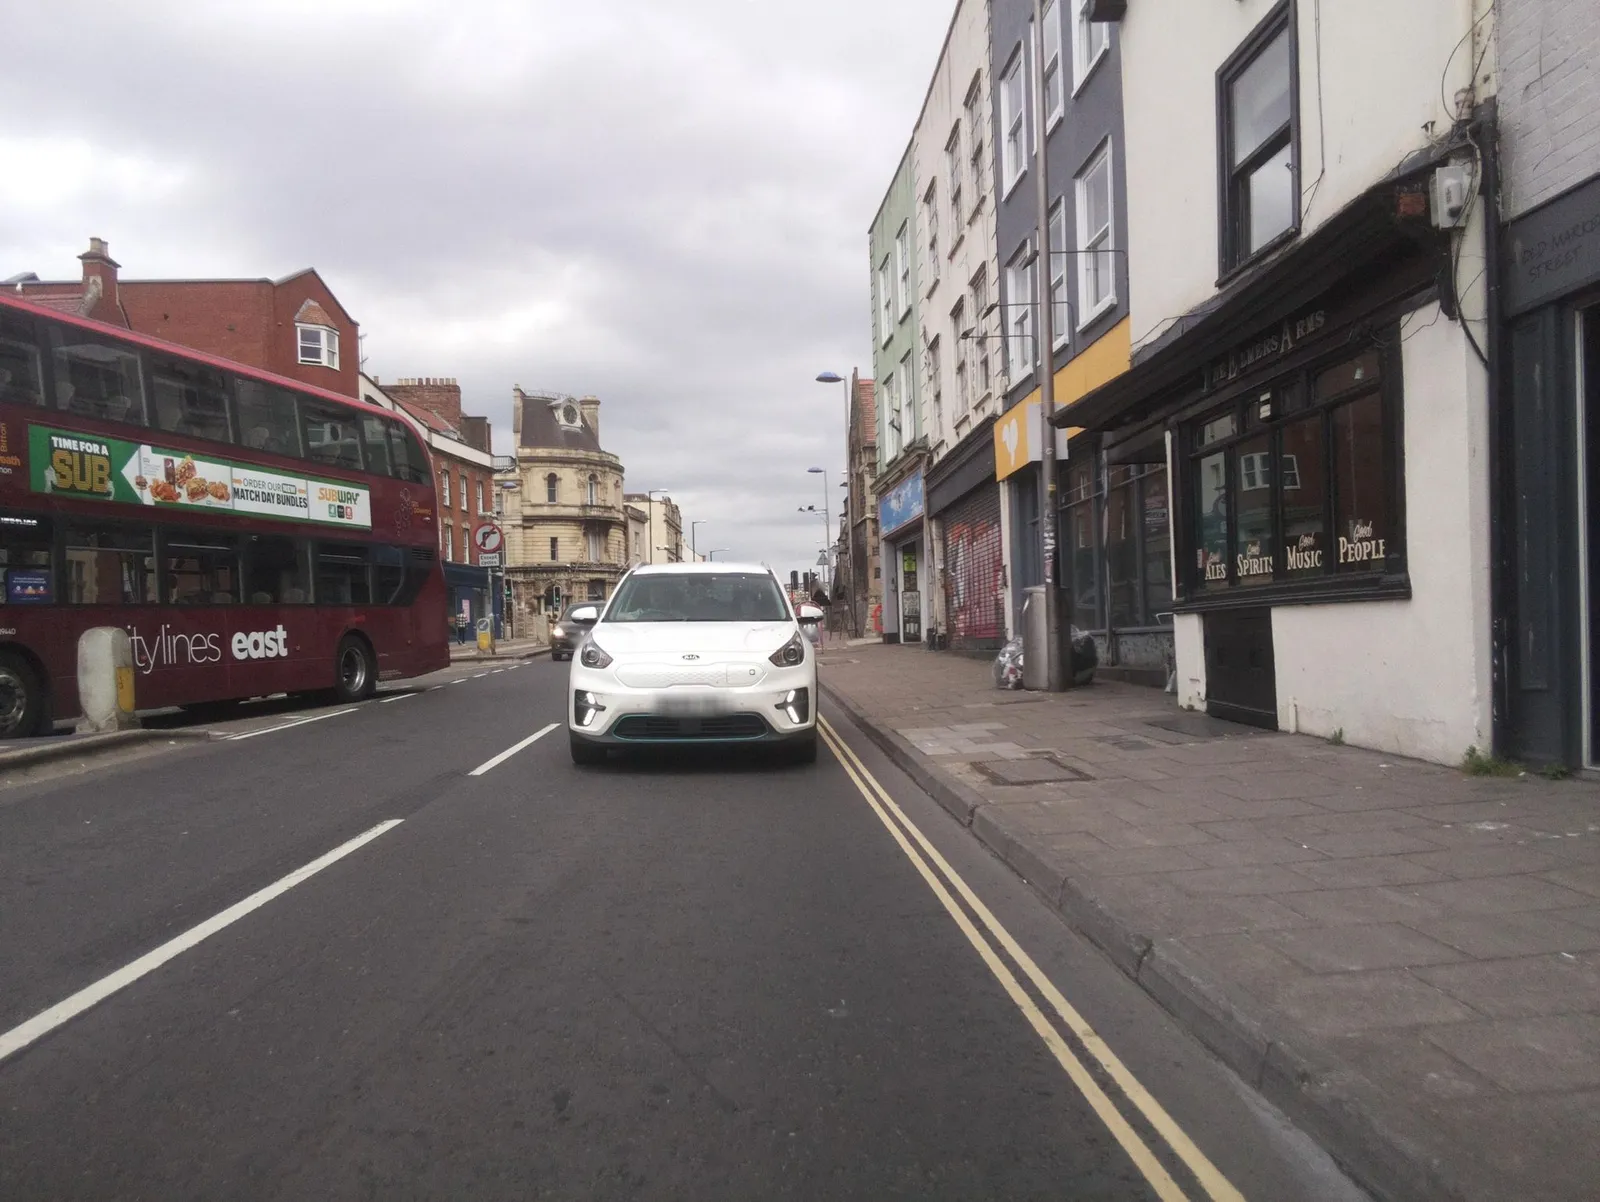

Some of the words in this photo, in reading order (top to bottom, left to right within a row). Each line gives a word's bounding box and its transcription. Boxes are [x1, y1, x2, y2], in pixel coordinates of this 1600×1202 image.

[1280, 310, 1325, 354] ARMS
[51, 436, 79, 450] TIME
[79, 441, 100, 454] FOR
[101, 444, 109, 456] A
[52, 449, 110, 493] SUB
[243, 478, 267, 489] ORDER
[267, 481, 281, 492] OUR
[318, 487, 360, 505] SUBWAY
[233, 487, 259, 502] MATCH
[261, 491, 275, 504] DAY
[276, 493, 308, 509] BUNDLES
[1354, 521, 1373, 542] Good
[1286, 546, 1322, 570] MUSIC
[231, 624, 288, 660] east
